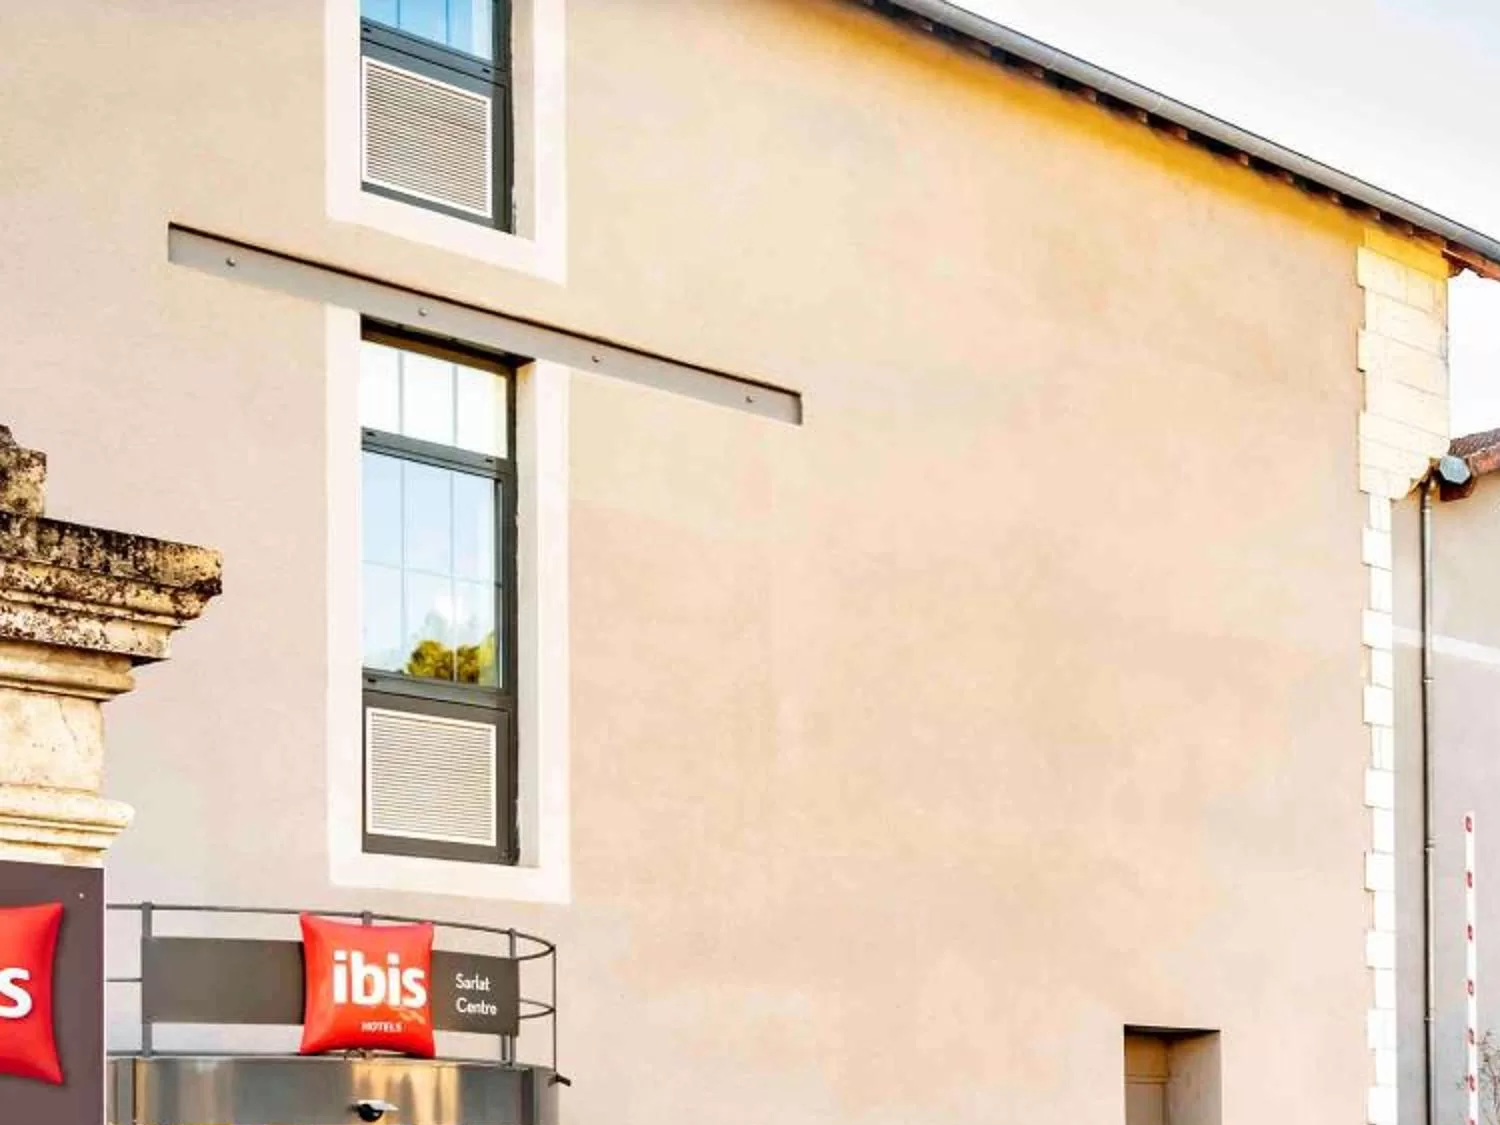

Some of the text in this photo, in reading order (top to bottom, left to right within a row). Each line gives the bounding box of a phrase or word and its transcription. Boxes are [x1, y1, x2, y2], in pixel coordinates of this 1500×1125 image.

[333, 949, 427, 1008] ibis
[455, 972, 491, 992] Sarlat
[455, 997, 498, 1016] Centre
